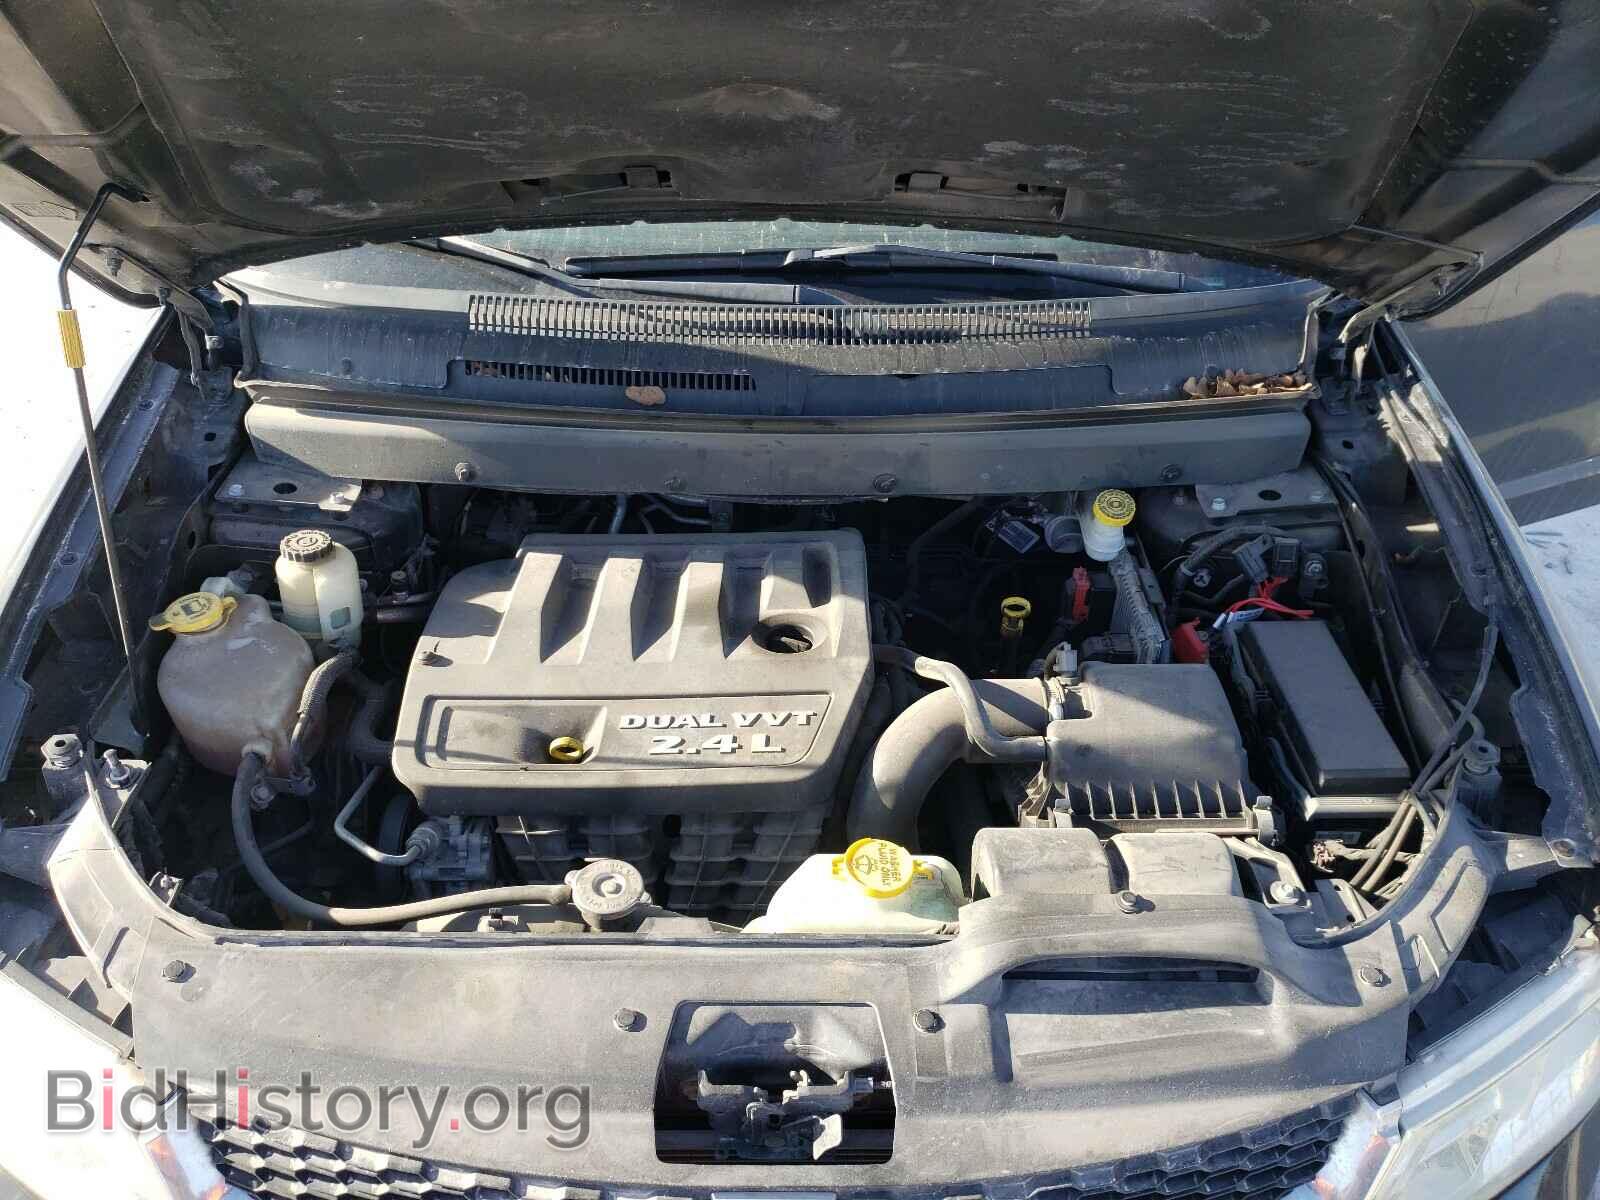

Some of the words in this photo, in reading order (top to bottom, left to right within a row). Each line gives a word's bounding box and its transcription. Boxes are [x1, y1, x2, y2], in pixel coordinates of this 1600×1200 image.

[620, 713, 727, 730] DUAL
[731, 711, 818, 727] VVT
[889, 848, 901, 882] WASHER
